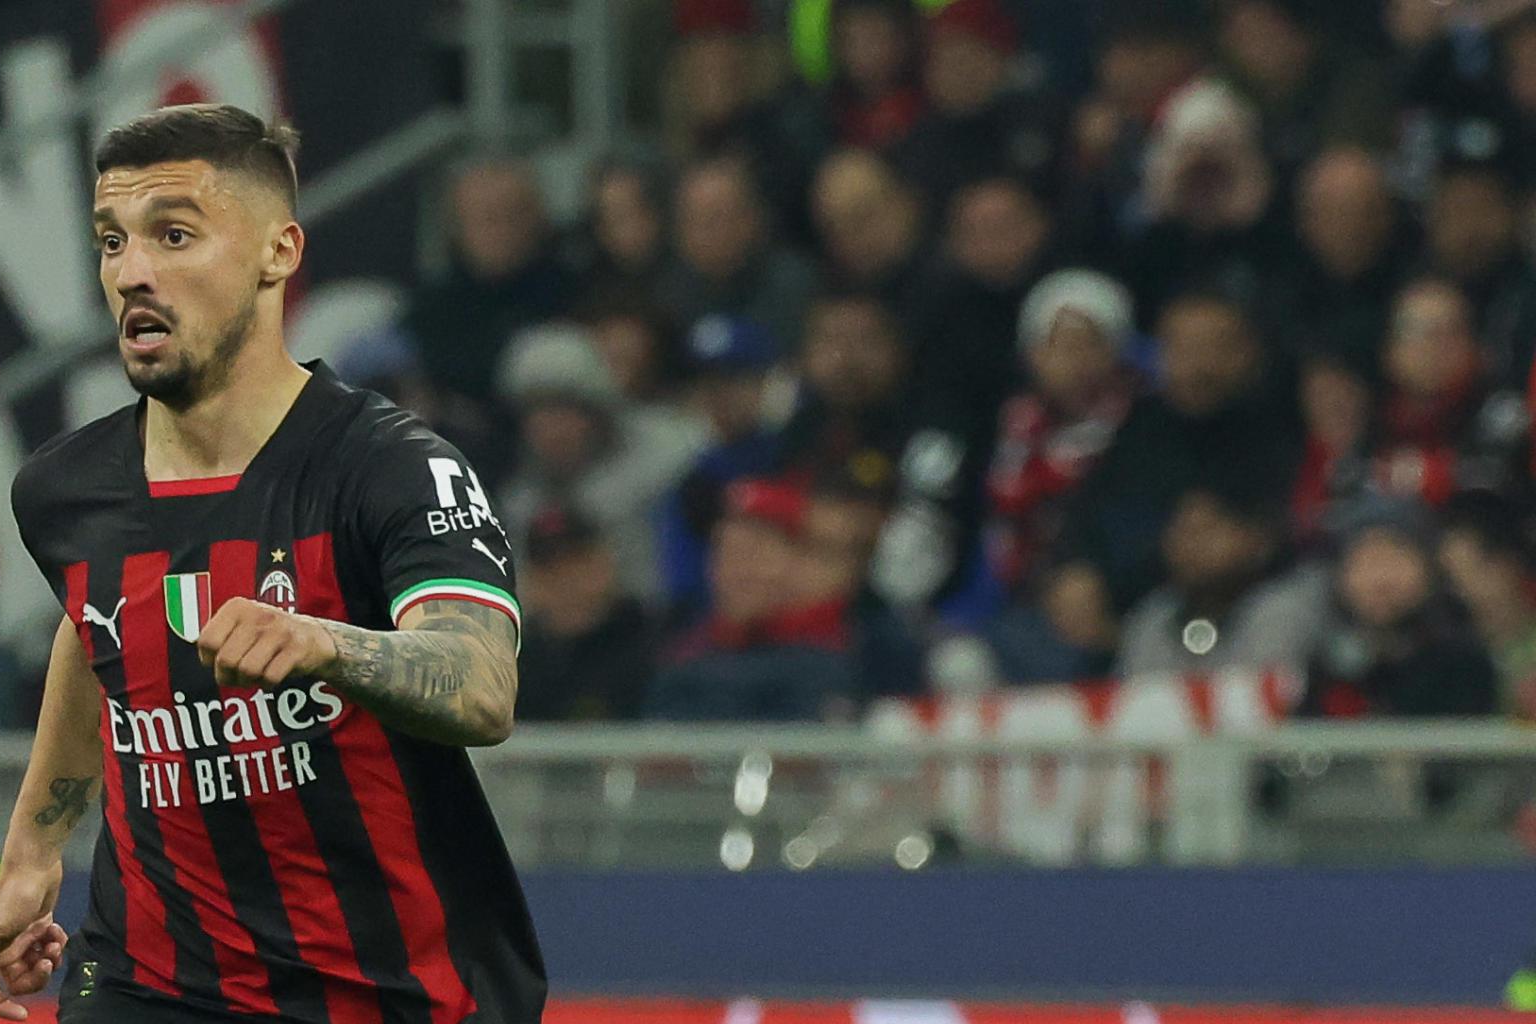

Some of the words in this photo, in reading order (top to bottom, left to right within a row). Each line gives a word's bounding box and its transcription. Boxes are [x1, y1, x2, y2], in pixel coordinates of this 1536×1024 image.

[106, 680, 344, 755] Emirates
[138, 761, 182, 809] FLY
[195, 740, 318, 806] BETTER
